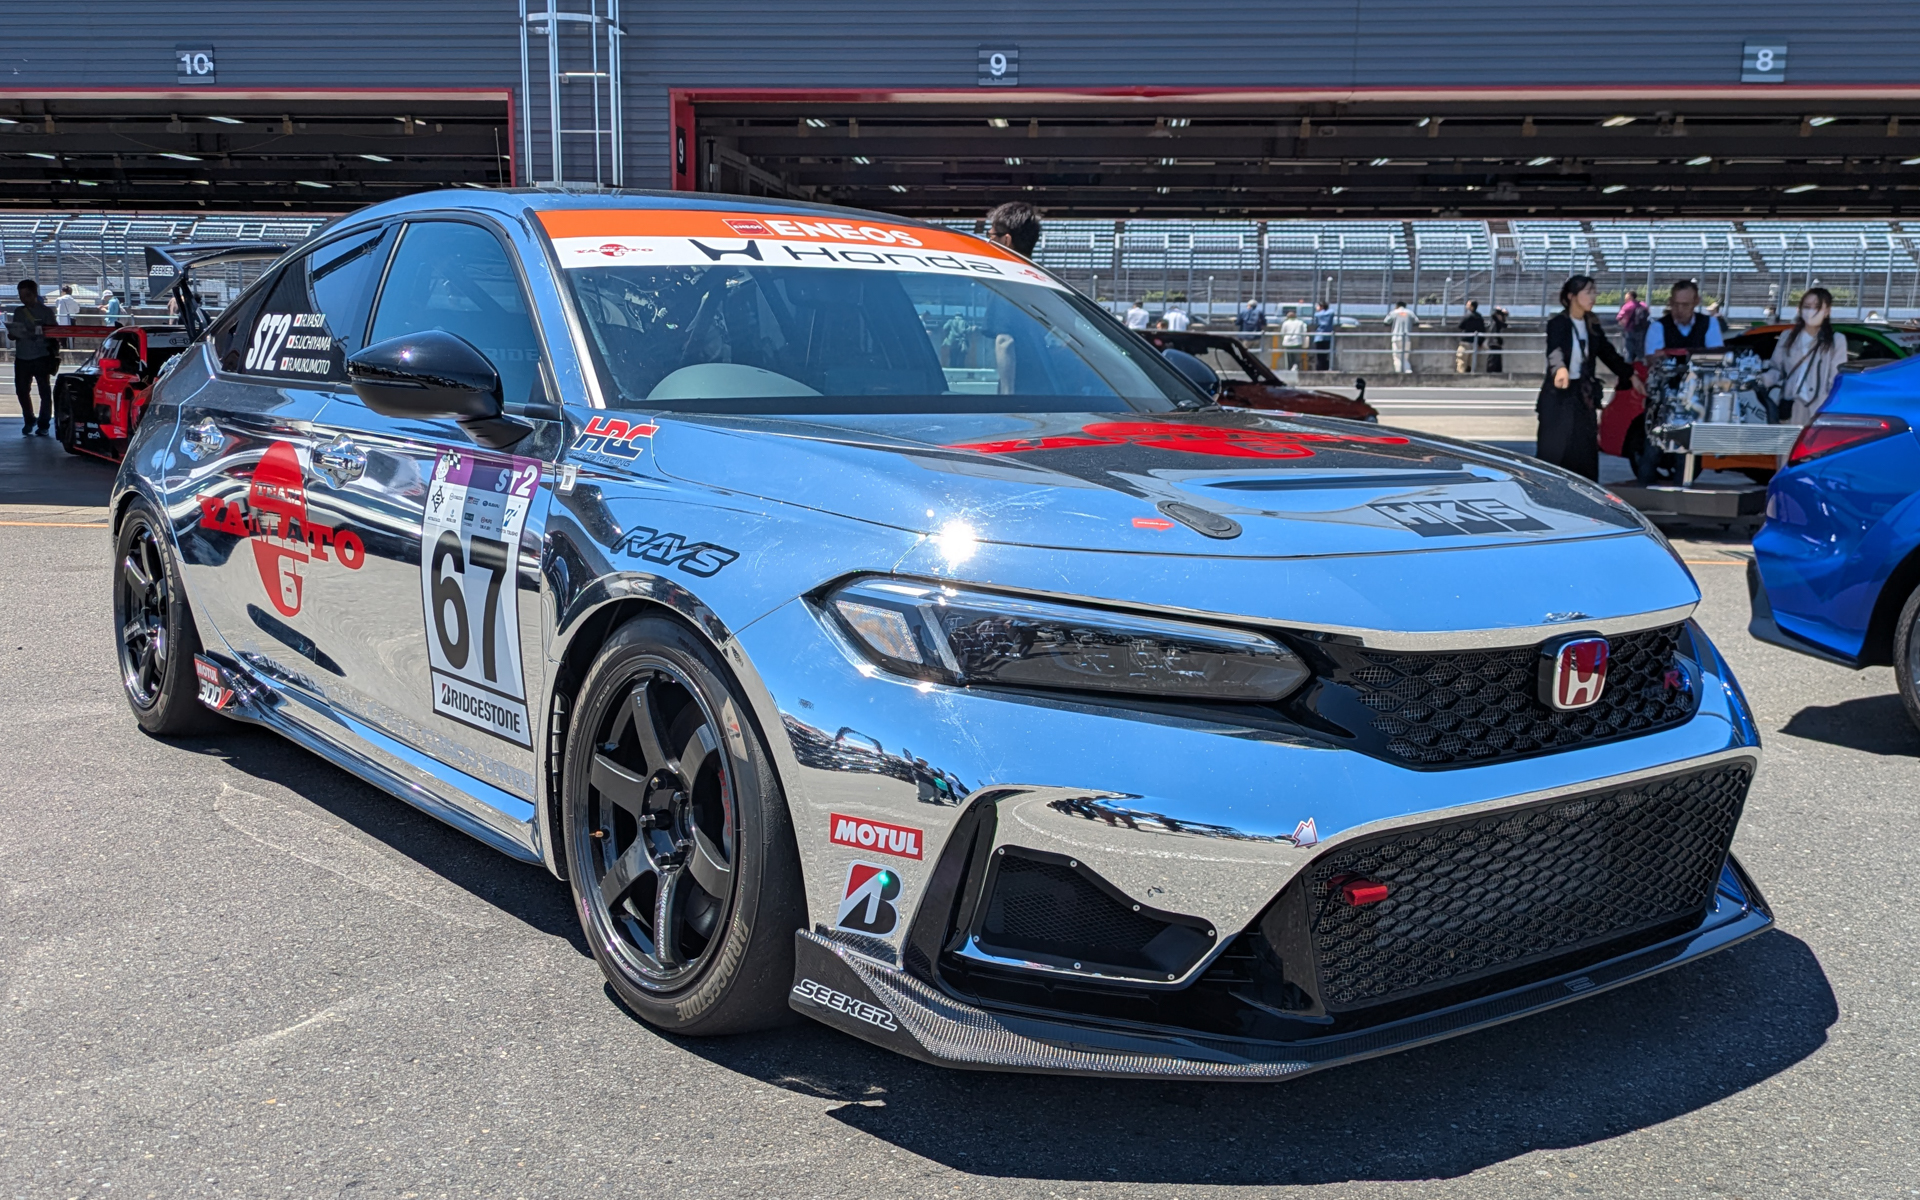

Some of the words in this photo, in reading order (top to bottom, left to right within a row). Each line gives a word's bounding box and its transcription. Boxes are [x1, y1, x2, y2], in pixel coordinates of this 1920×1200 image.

[181, 53, 213, 75] 10
[990, 53, 1007, 76] 9
[1756, 49, 1773, 72] 8
[678, 137, 684, 164] 9
[764, 219, 923, 247] ENEOS
[780, 245, 1005, 275] Honda
[245, 313, 292, 371] ST2
[570, 415, 660, 461] HRC
[255, 481, 303, 506] TEAM
[495, 464, 539, 498] ST2
[1368, 500, 1540, 529] HKS
[611, 525, 741, 579] RAYS
[430, 529, 510, 684] 67
[197, 678, 234, 710] 300V
[441, 682, 522, 735] BRIDGESTONE
[833, 818, 920, 856] MOTUL
[675, 920, 750, 1023] BRIDGESTONE
[792, 978, 898, 1031] SEEKER
